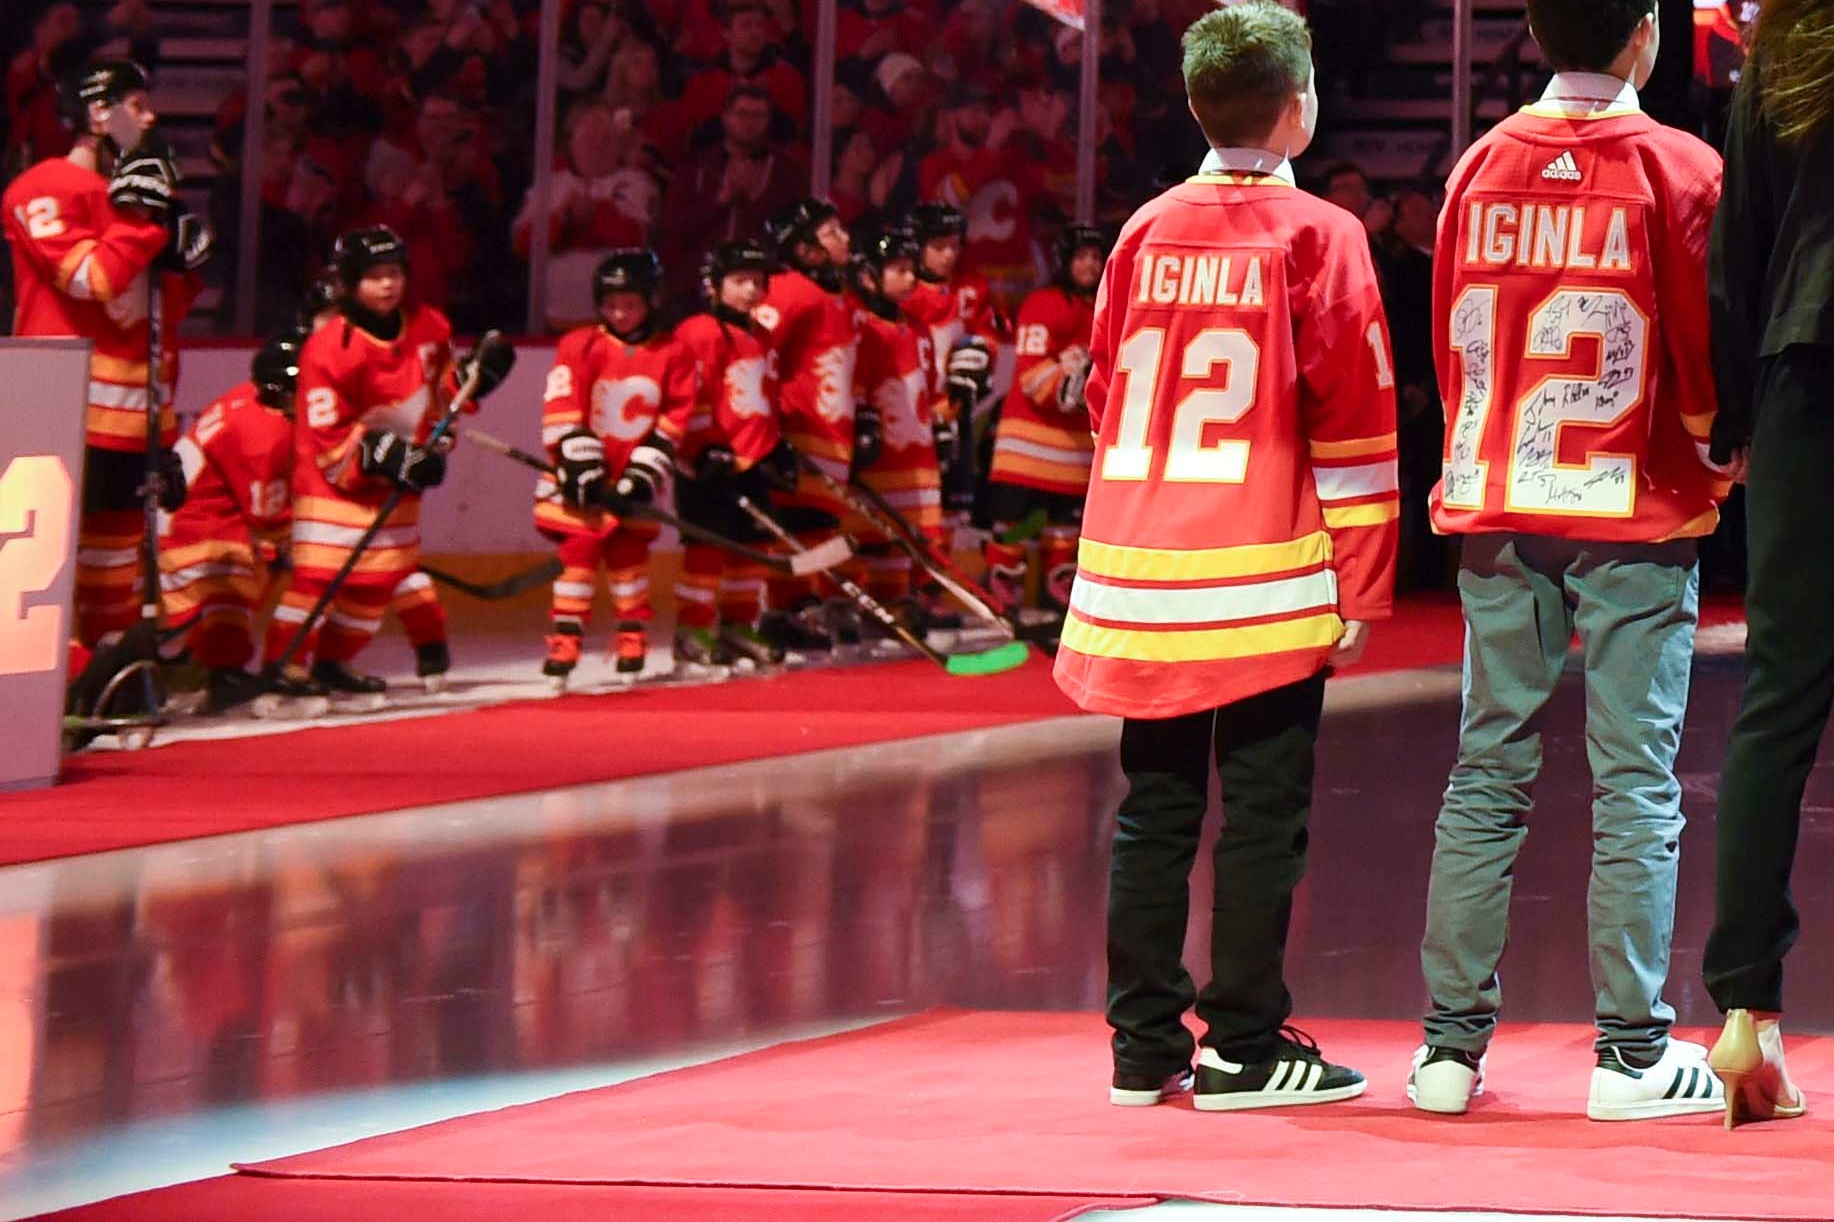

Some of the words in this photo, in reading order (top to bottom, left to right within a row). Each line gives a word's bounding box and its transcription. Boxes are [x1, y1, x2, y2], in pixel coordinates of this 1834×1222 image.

[1138, 254, 1265, 307] IGINLA
[1464, 200, 1637, 271] IGINLA
[1102, 327, 1260, 483] 12
[1442, 283, 1651, 518] 12
